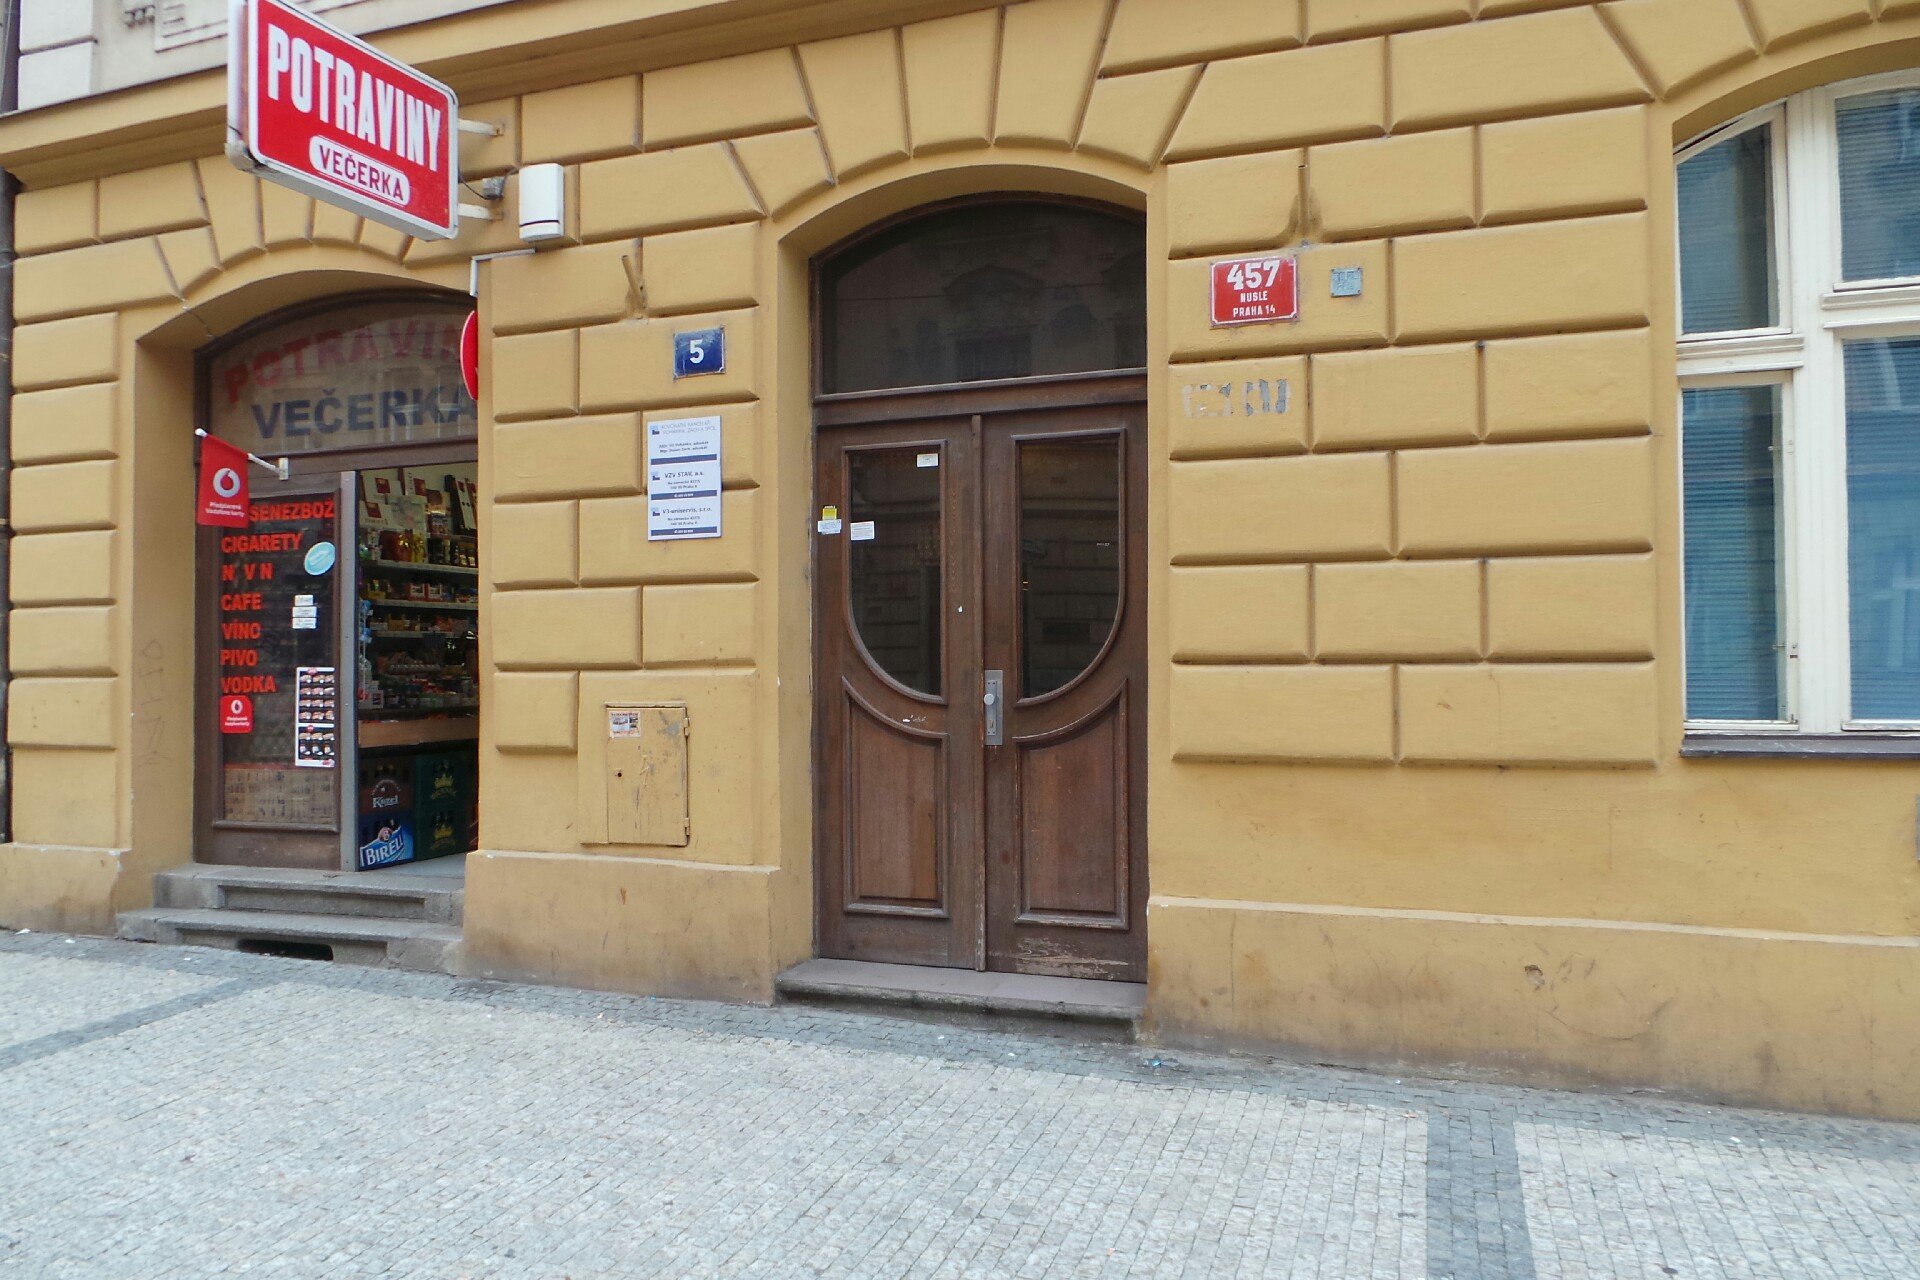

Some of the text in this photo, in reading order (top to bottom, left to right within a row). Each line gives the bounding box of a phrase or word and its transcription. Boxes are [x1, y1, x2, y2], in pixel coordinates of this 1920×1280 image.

[267, 23, 441, 172] POTRAVINY
[319, 143, 404, 201] VEČERKA
[1226, 259, 1280, 291] 457
[1240, 290, 1268, 303] NUSLE
[1232, 303, 1276, 318] PRAHA 14
[689, 339, 705, 364] 5
[221, 532, 304, 554] CIGARETY
[220, 648, 259, 667] PIVO
[220, 675, 277, 694] VODKA
